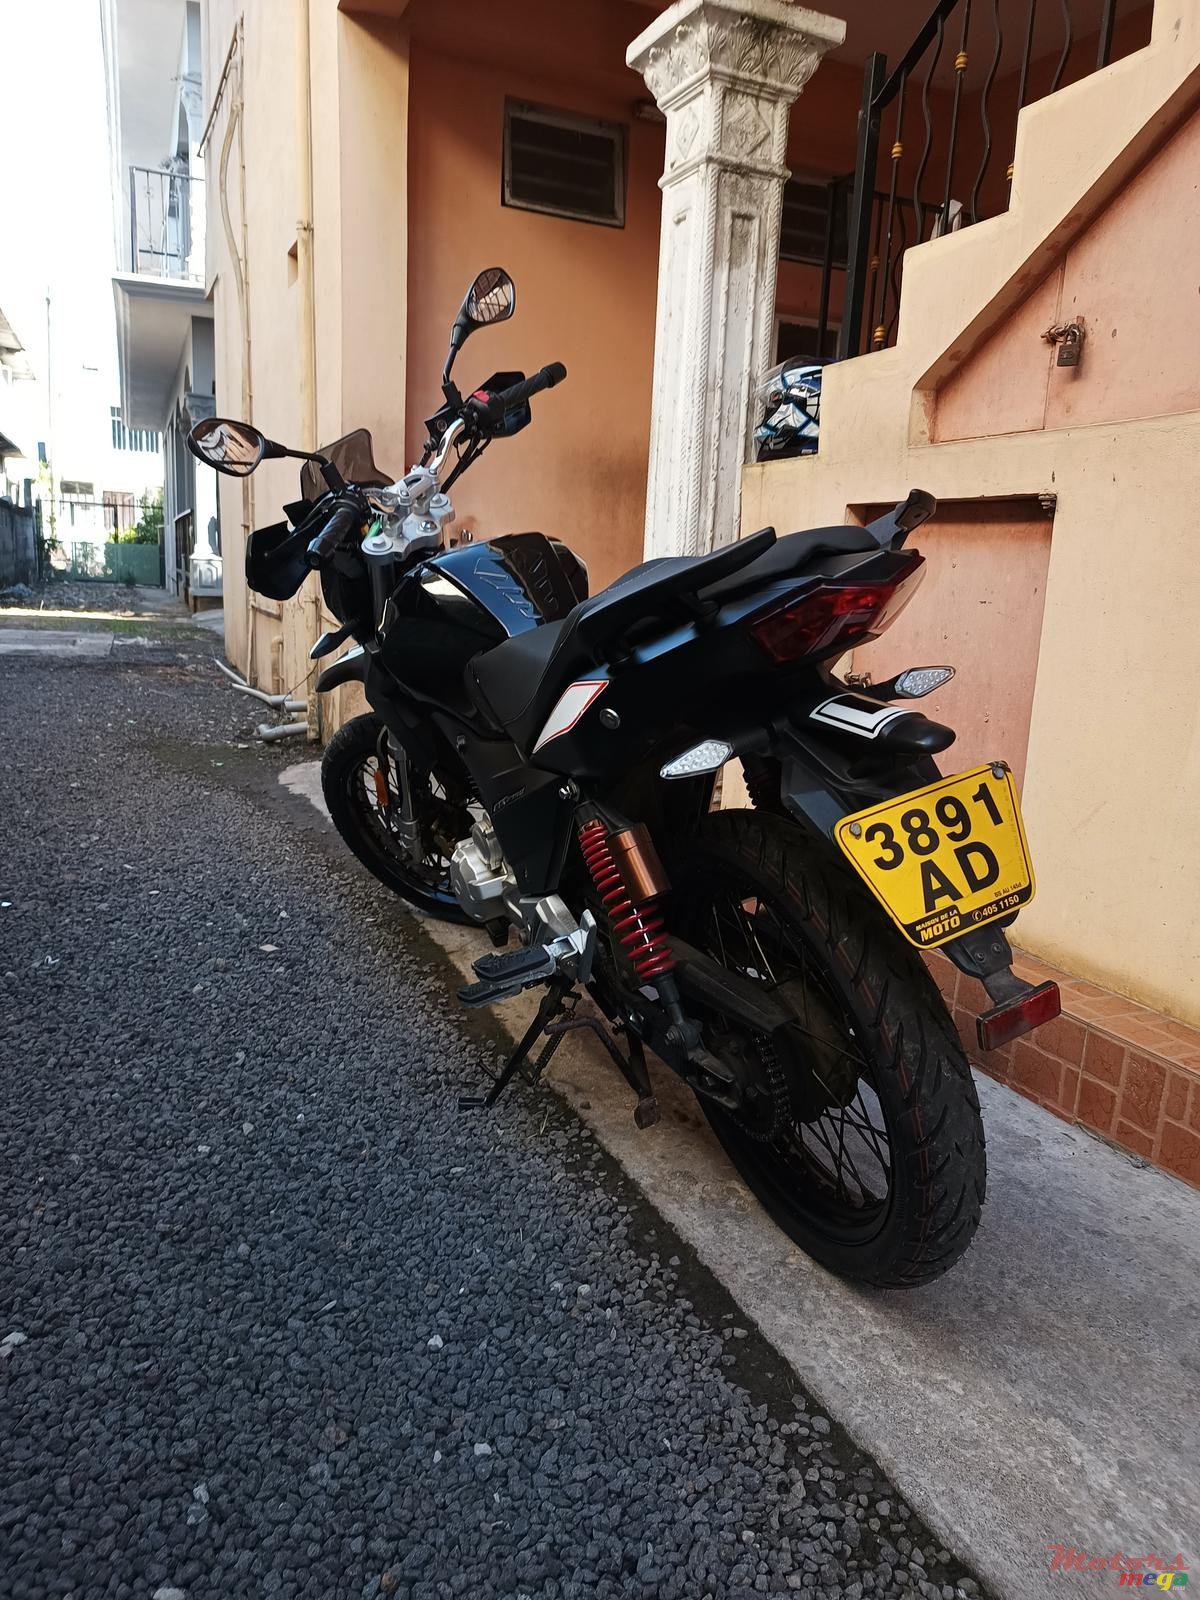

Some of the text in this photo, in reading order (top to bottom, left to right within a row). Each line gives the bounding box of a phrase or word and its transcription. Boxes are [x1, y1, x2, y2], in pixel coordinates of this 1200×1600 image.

[864, 782, 1004, 871] 3891
[920, 841, 1000, 914] AD
[982, 894, 1020, 917] 405 1150
[915, 909, 958, 931] MAISON DE LA
[920, 915, 961, 942] MOTO
